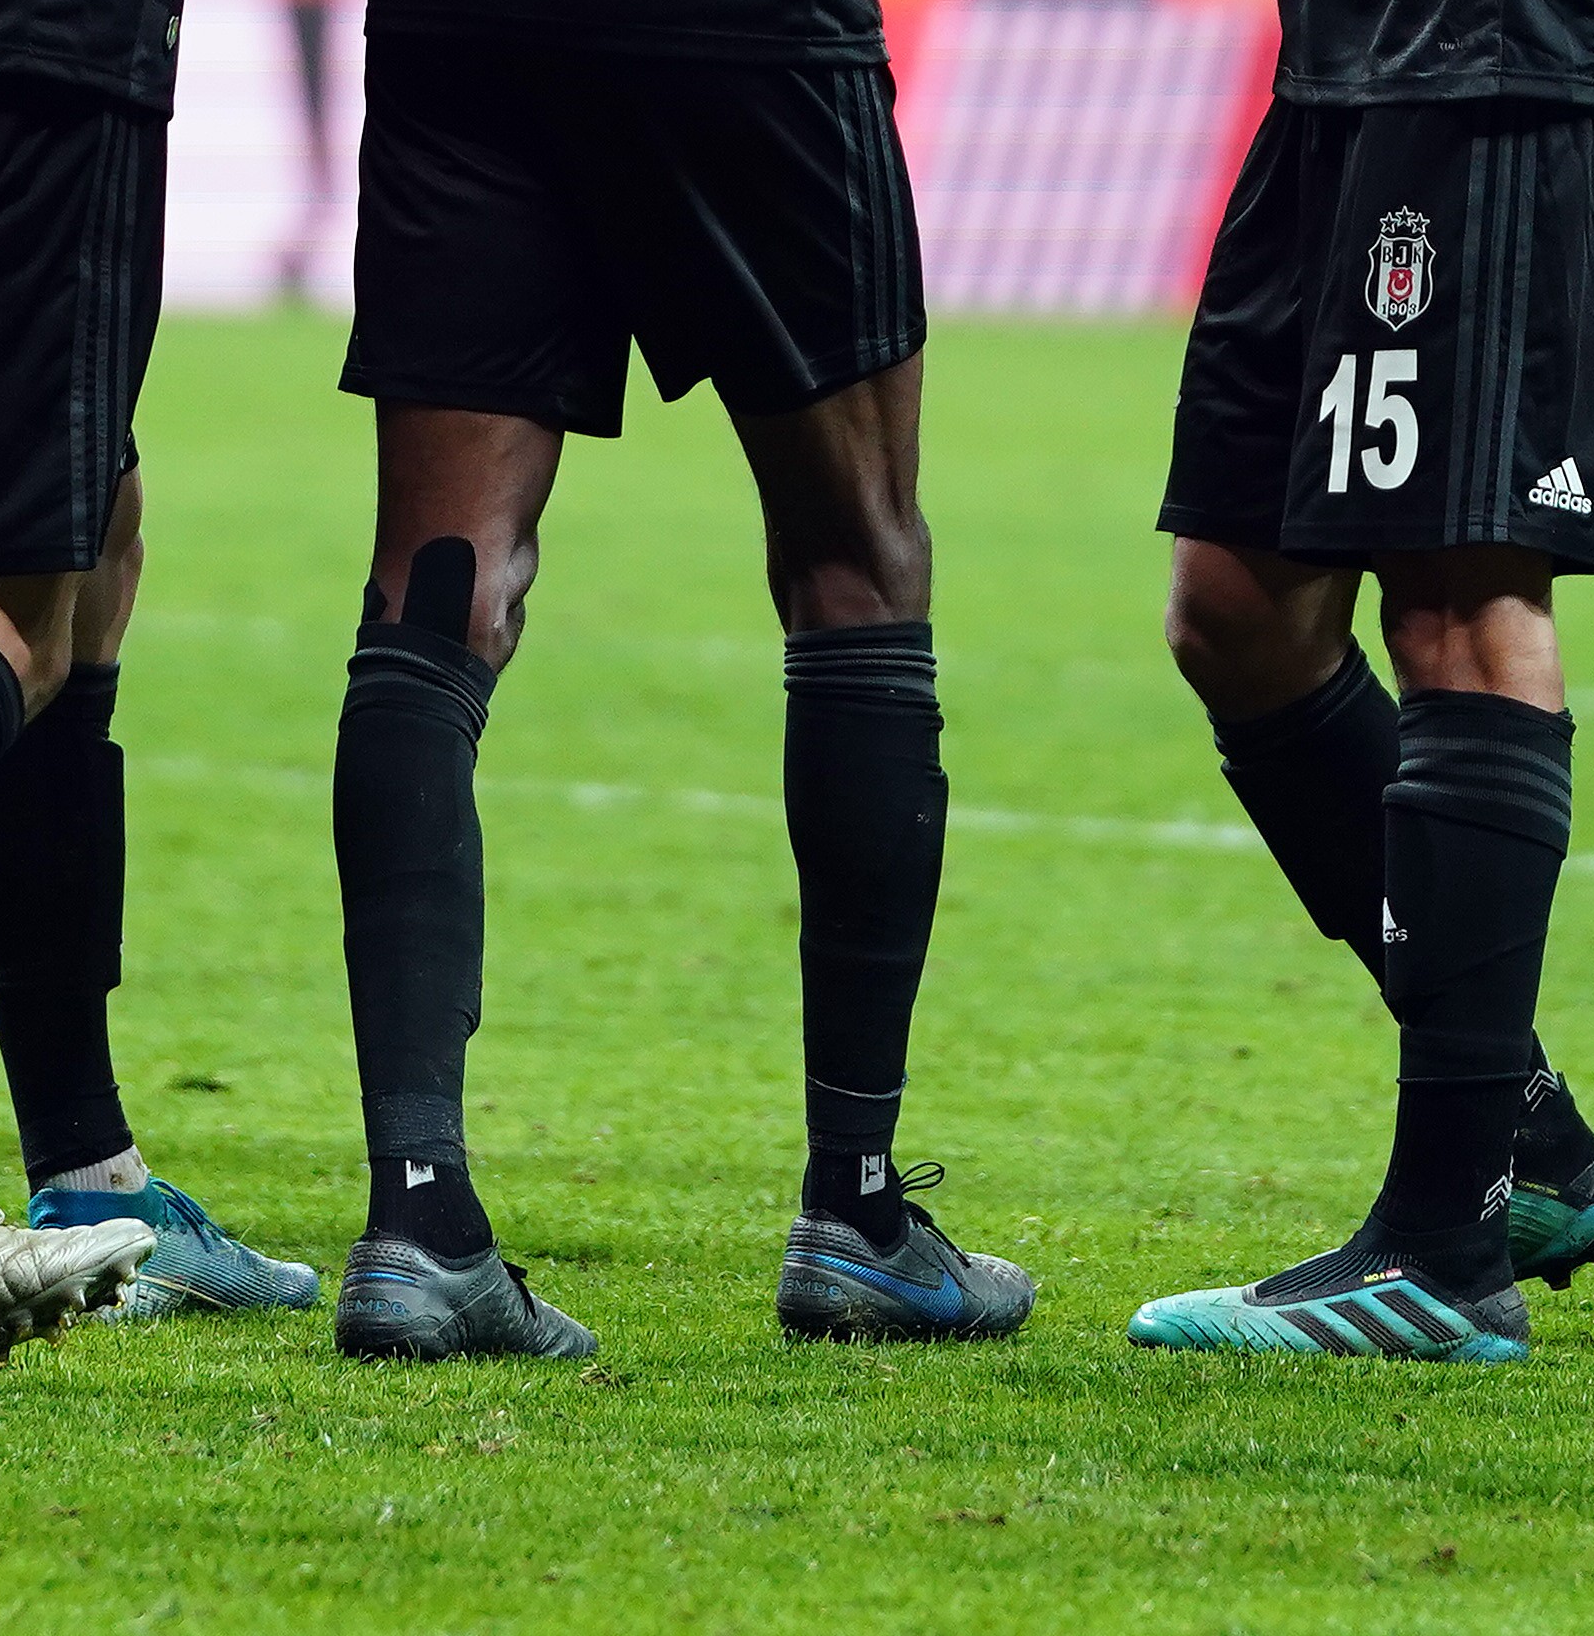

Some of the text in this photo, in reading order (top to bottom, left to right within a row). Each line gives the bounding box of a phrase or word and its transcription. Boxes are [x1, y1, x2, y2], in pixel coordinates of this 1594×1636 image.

[1382, 245, 1423, 264] BJK
[1379, 302, 1418, 317] 1903
[1318, 349, 1419, 493] 15
[1528, 487, 1592, 514] adidas
